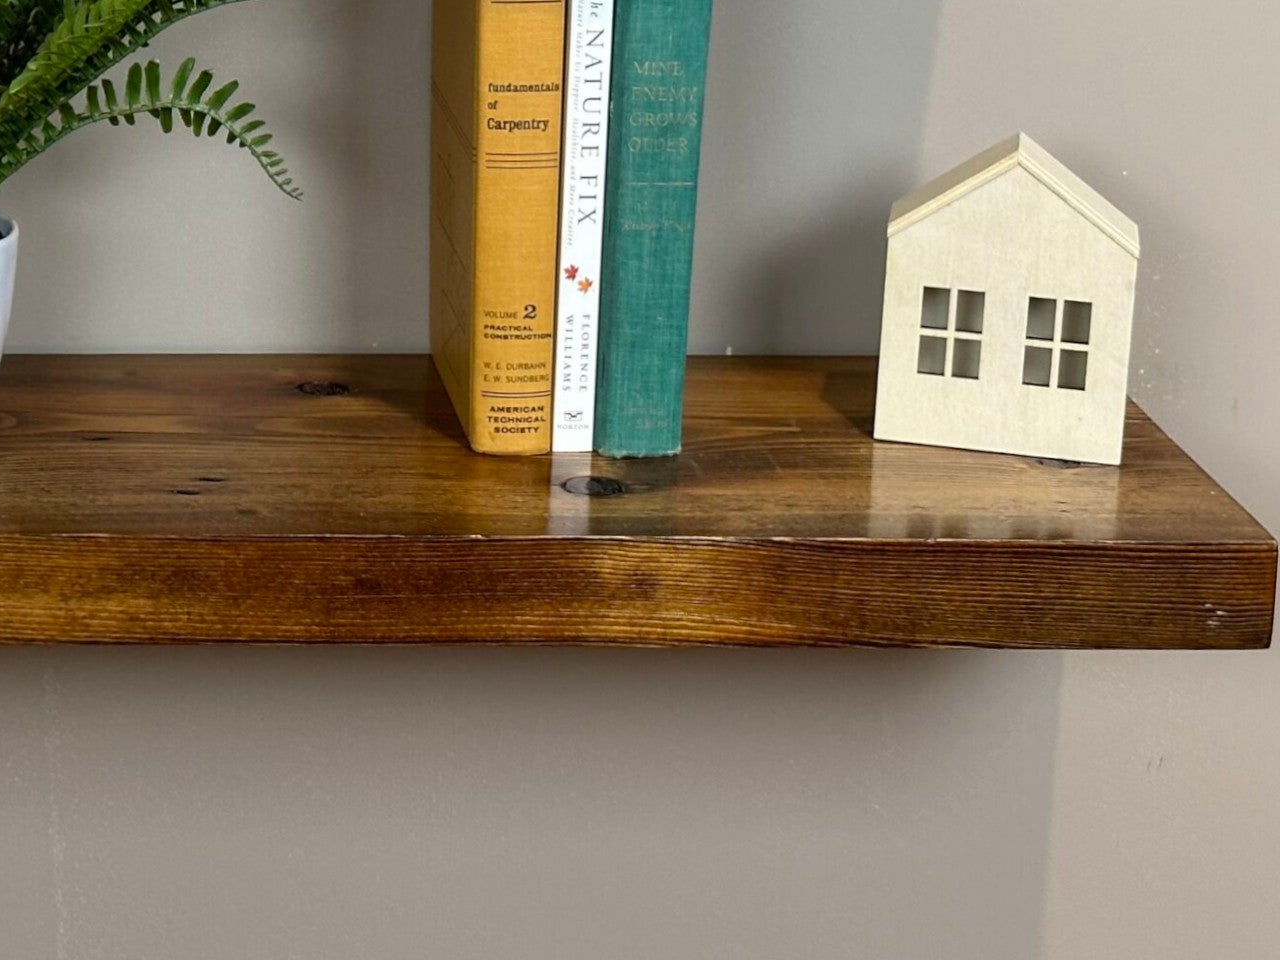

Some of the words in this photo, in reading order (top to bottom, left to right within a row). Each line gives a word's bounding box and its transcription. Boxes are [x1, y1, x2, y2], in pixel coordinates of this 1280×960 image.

[633, 60, 683, 76] MINE
[488, 82, 559, 93] fundamentals
[581, 28, 605, 159] NATURE
[631, 86, 697, 102] ENEMY
[487, 100, 498, 110] of
[487, 118, 549, 132] Carpentry
[629, 112, 697, 127] GROWS
[577, 174, 599, 225] FIX
[483, 310, 519, 319] VOLUME
[522, 304, 537, 319] 2
[483, 324, 534, 332] PRACTICAL
[562, 314, 574, 392] WILLIAMS
[579, 313, 591, 392] FLORENCE
[505, 362, 546, 371] DURBAHN
[505, 374, 550, 384] SUNDBERG
[489, 406, 545, 414] AMERICAN
[487, 416, 547, 424] TECHNICAL
[493, 426, 540, 434] SOCIETY
